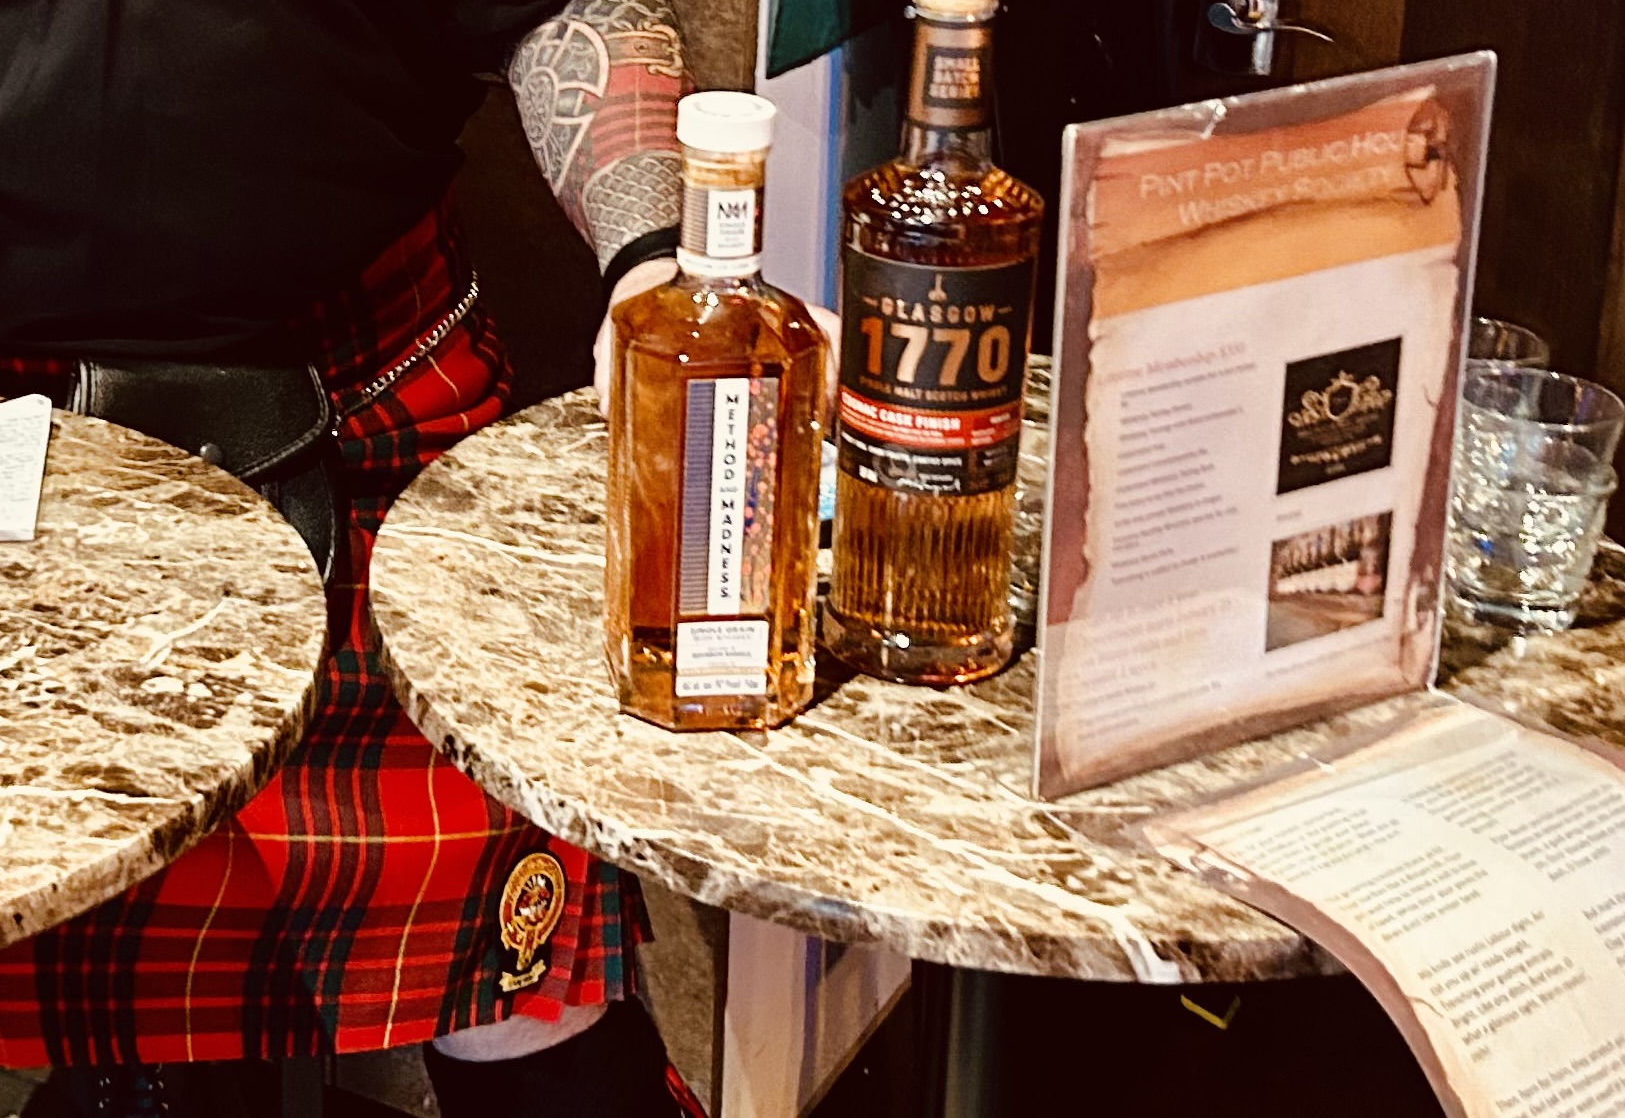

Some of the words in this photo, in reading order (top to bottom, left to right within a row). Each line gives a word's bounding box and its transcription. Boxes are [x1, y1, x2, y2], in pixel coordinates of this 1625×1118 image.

[1203, 157, 1257, 187] POT
[880, 295, 996, 325] GLASGOW
[859, 316, 1012, 387] 1770
[878, 408, 914, 427] CASK
[723, 393, 740, 481] METHOD
